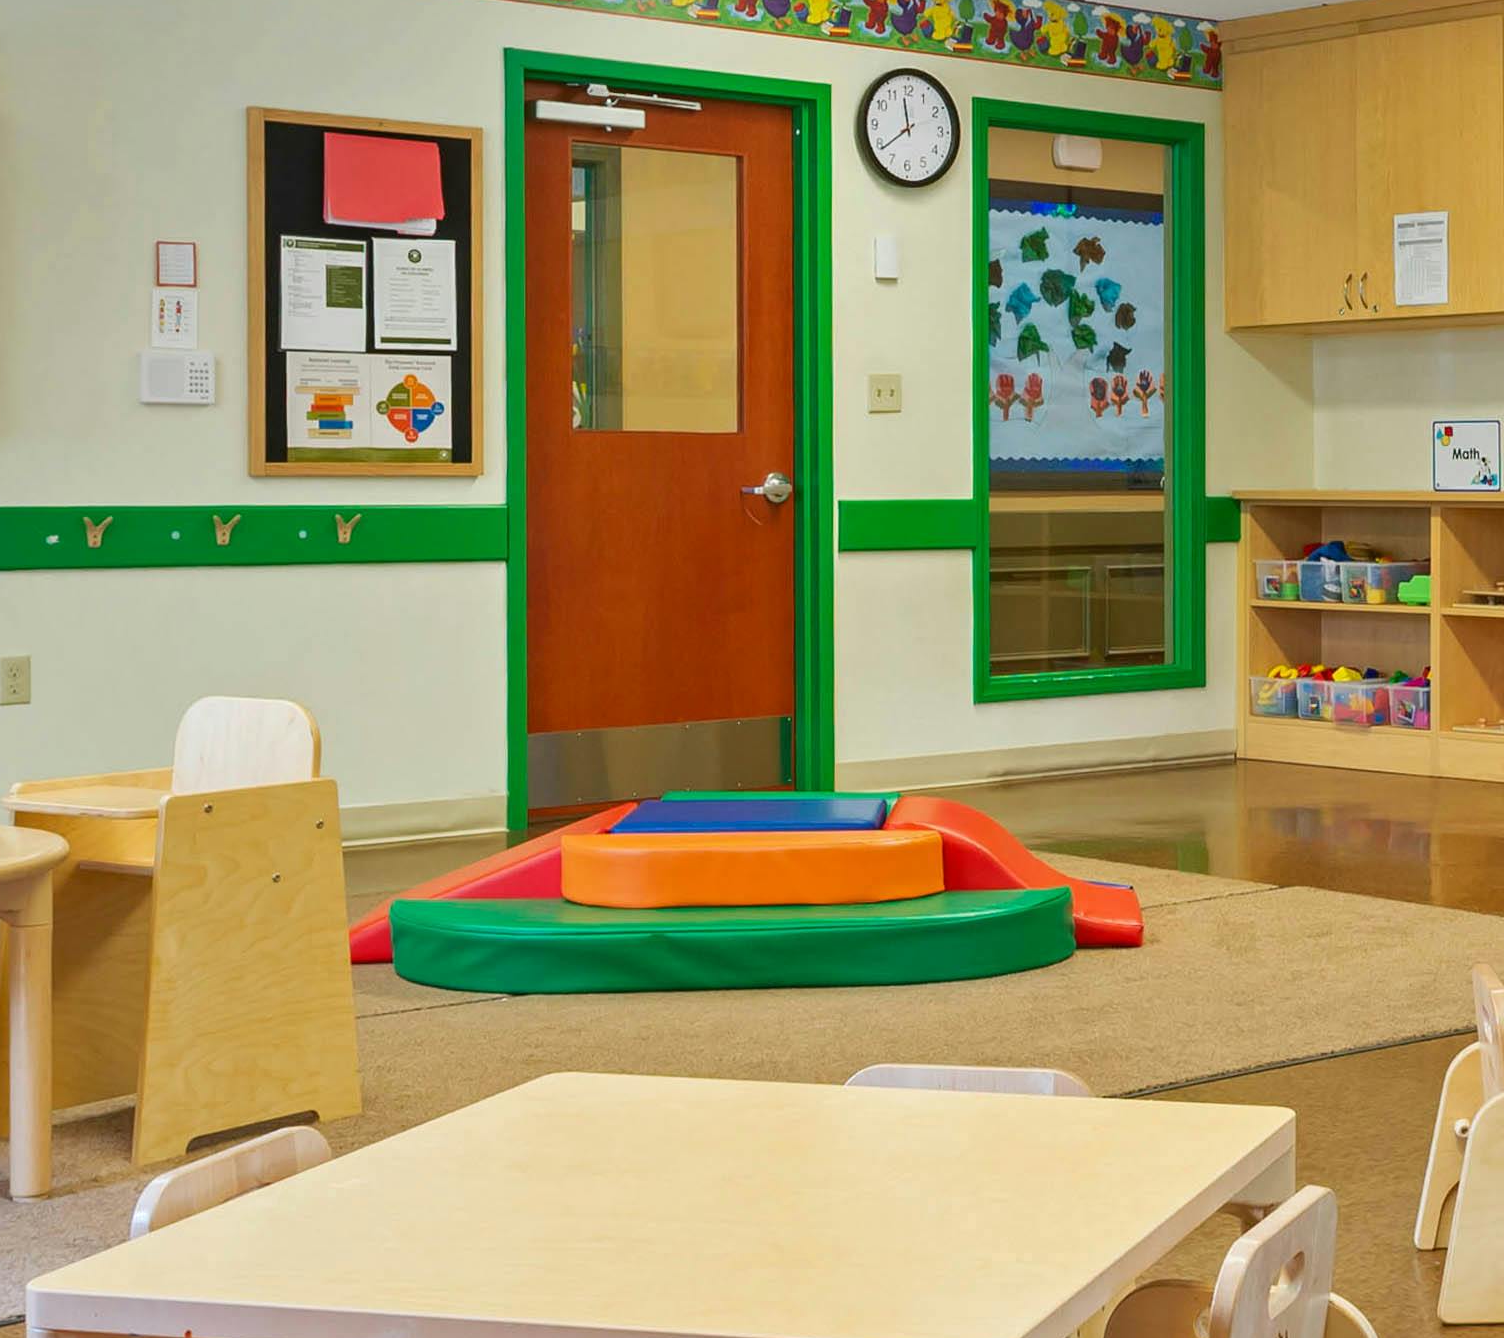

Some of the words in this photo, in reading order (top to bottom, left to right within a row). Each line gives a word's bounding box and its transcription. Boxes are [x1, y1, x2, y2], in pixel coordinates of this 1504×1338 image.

[887, 89, 897, 101] 11
[903, 85, 914, 97] 12
[876, 99, 888, 111] 10
[932, 106, 939, 118] 2
[871, 118, 878, 130] 9
[937, 126, 944, 138] 3
[876, 138, 884, 150] 8
[931, 145, 938, 155] 4
[888, 153, 896, 164] 7
[920, 157, 927, 168] 5
[904, 160, 911, 171] 6
[1452, 447, 1480, 460] Math
